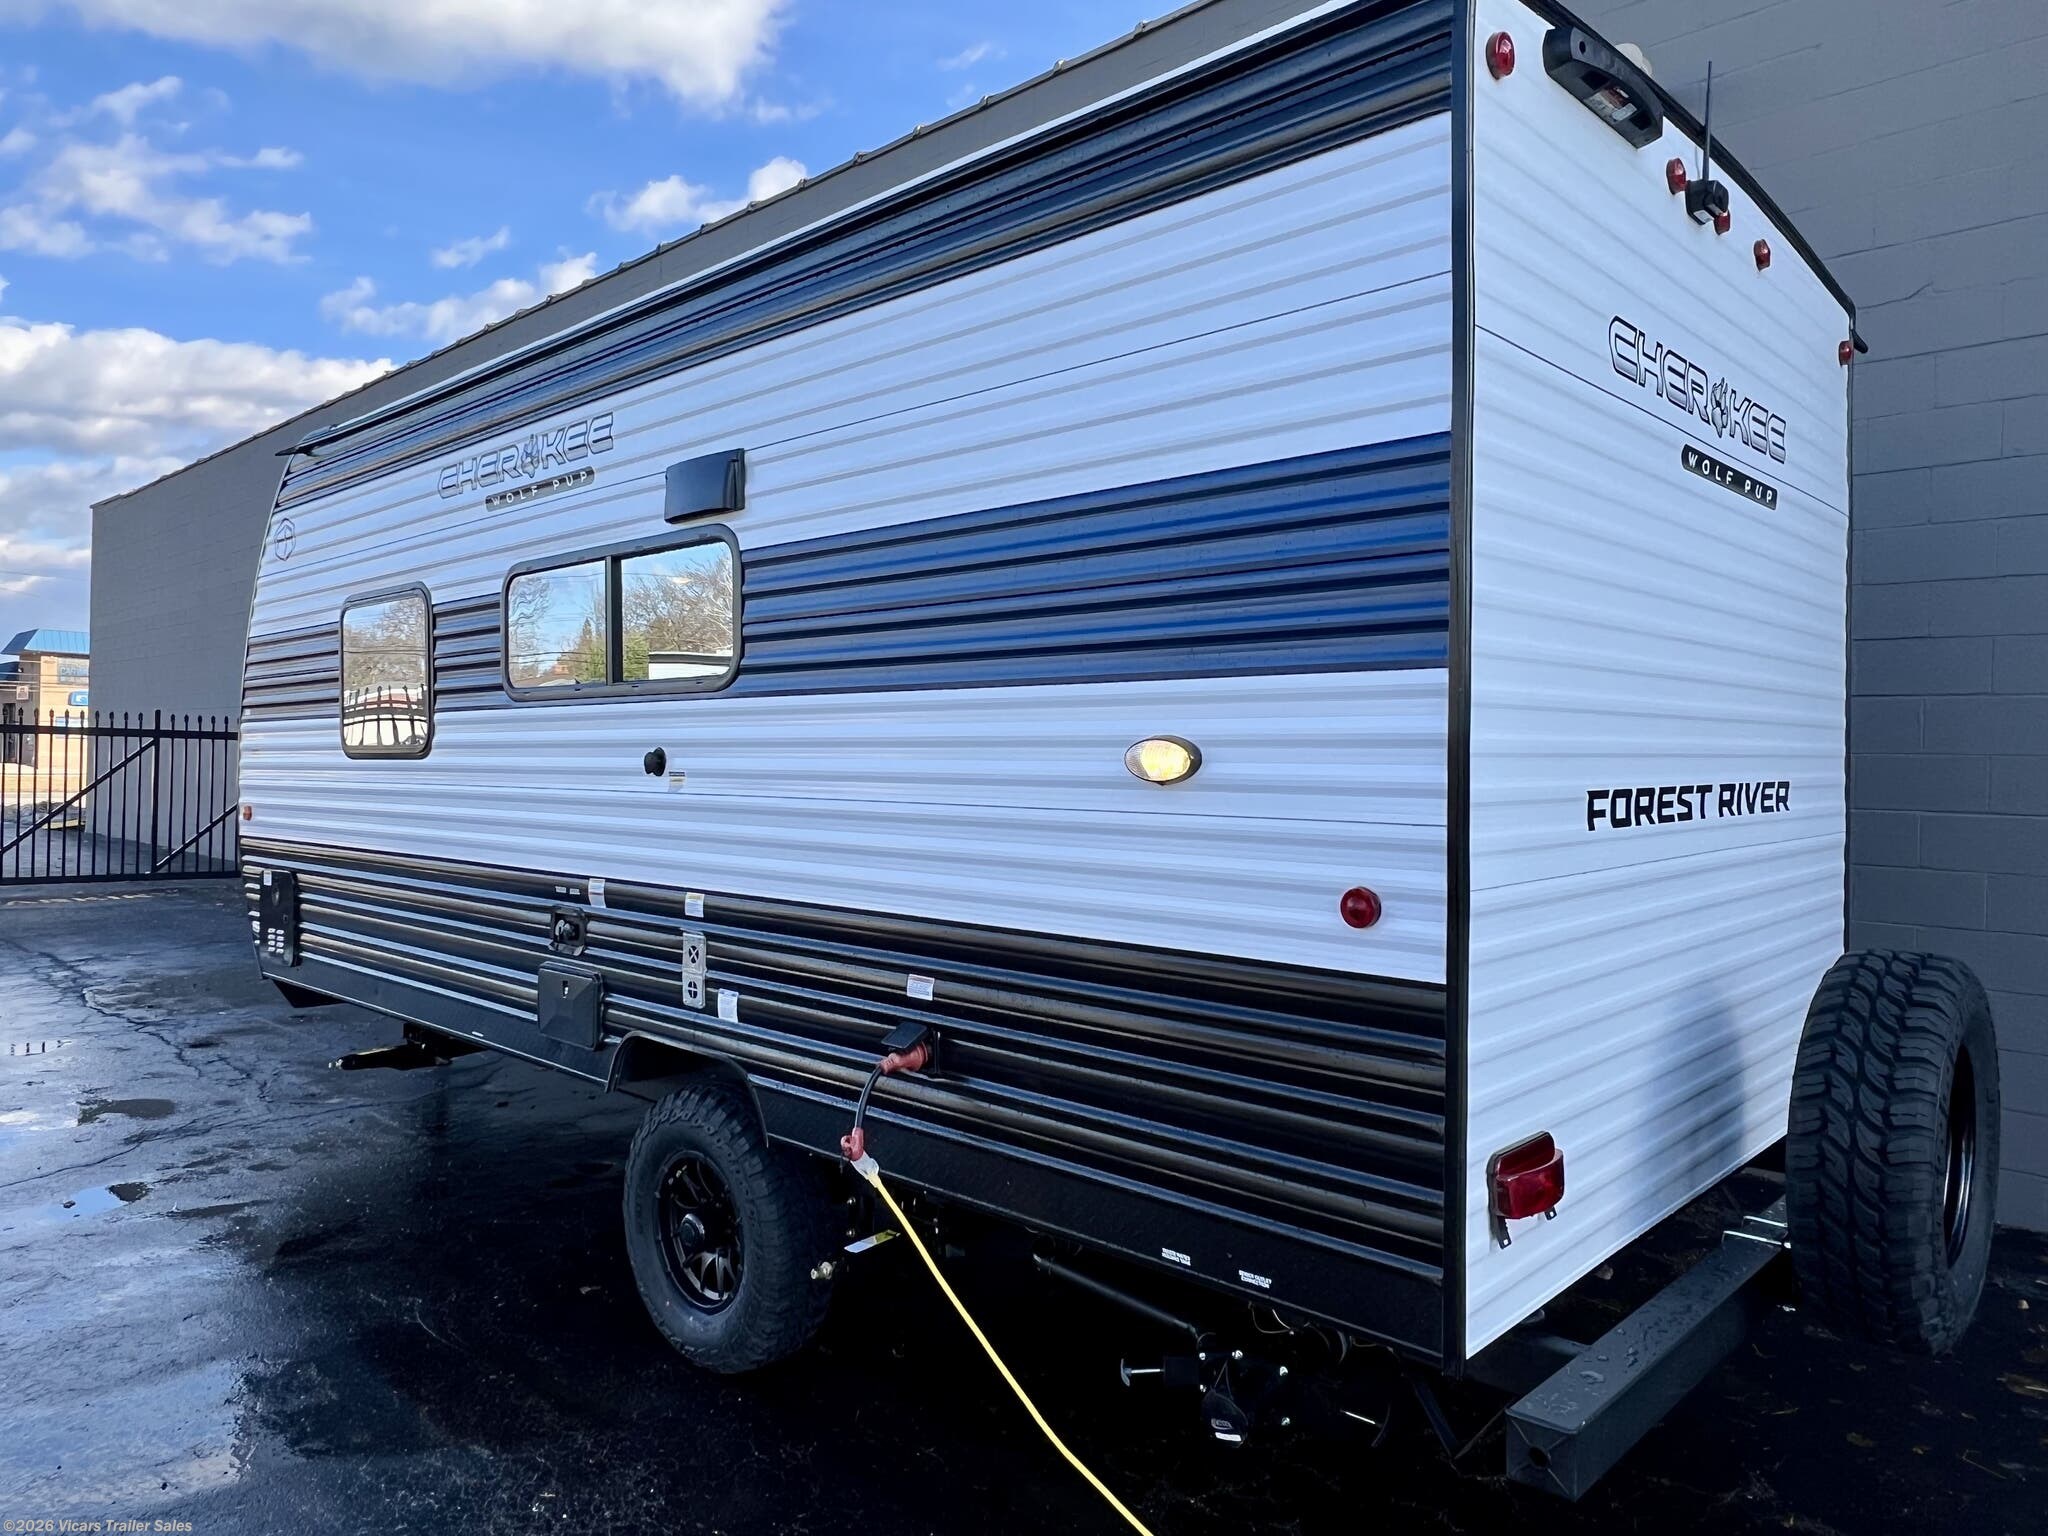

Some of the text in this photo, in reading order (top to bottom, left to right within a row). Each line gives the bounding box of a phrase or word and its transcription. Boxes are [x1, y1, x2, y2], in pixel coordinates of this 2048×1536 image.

[491, 470, 588, 506] WOLF PUP
[1688, 451, 1773, 504] WOLF PUP
[1586, 780, 1790, 832] FOREST RIVER
